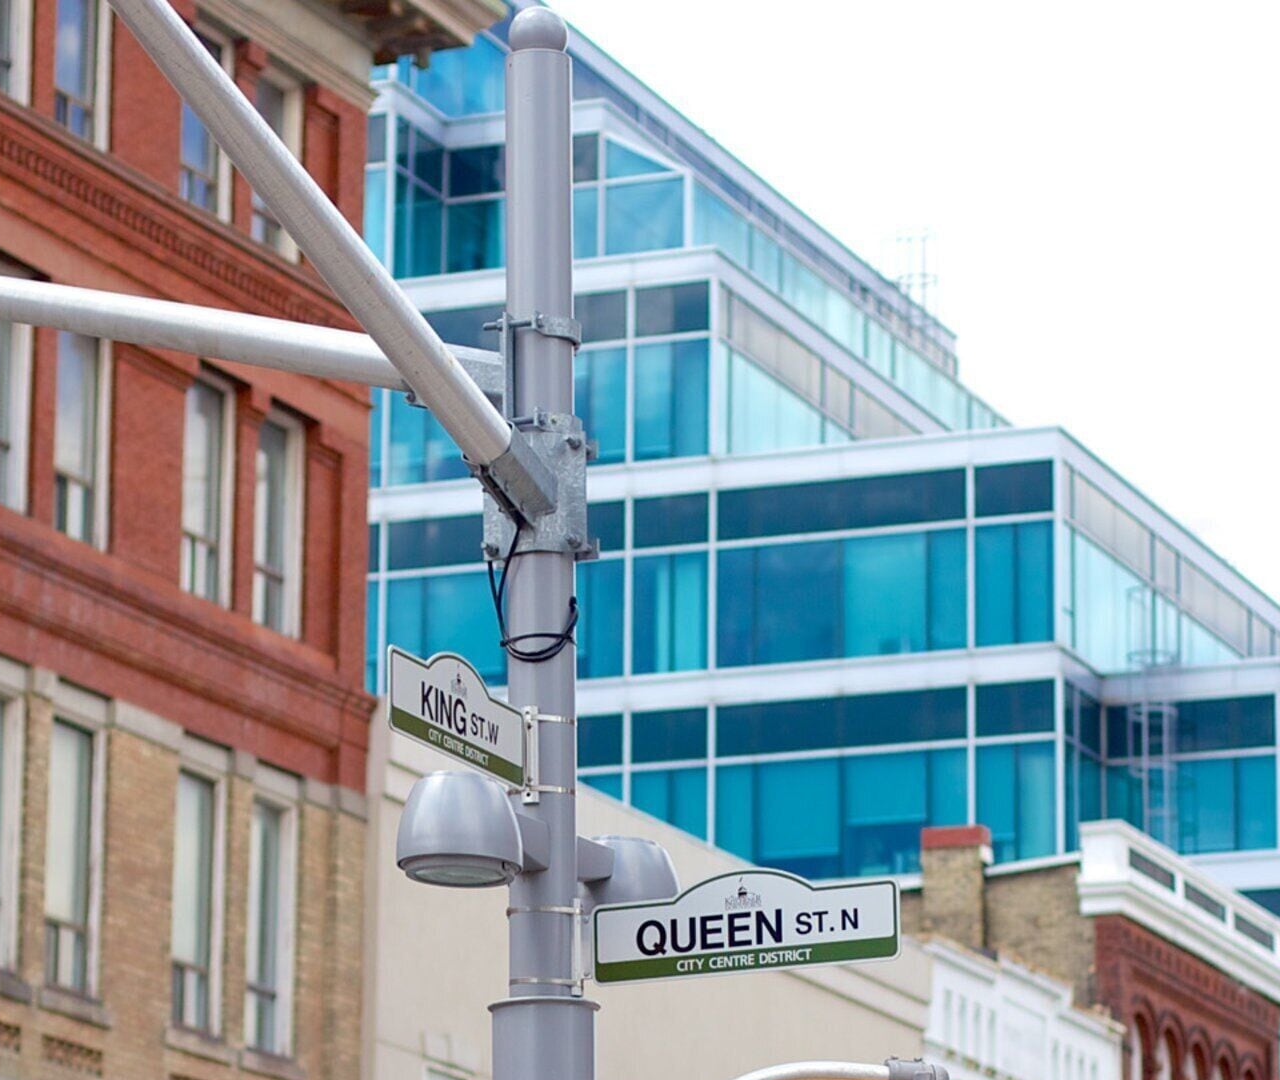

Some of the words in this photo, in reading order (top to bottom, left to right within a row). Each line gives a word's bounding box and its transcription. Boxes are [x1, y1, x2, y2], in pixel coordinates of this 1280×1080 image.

[421, 680, 467, 736] KING
[428, 728, 441, 742] CITY
[443, 735, 465, 755] CENTRE
[464, 745, 489, 766] DISTRICT
[636, 908, 783, 956] QUEEN
[795, 911, 835, 935] ST.
[841, 908, 859, 931] N
[676, 958, 704, 973] CITY
[708, 953, 755, 969] CENTRE
[759, 948, 812, 965] DISTRICT
